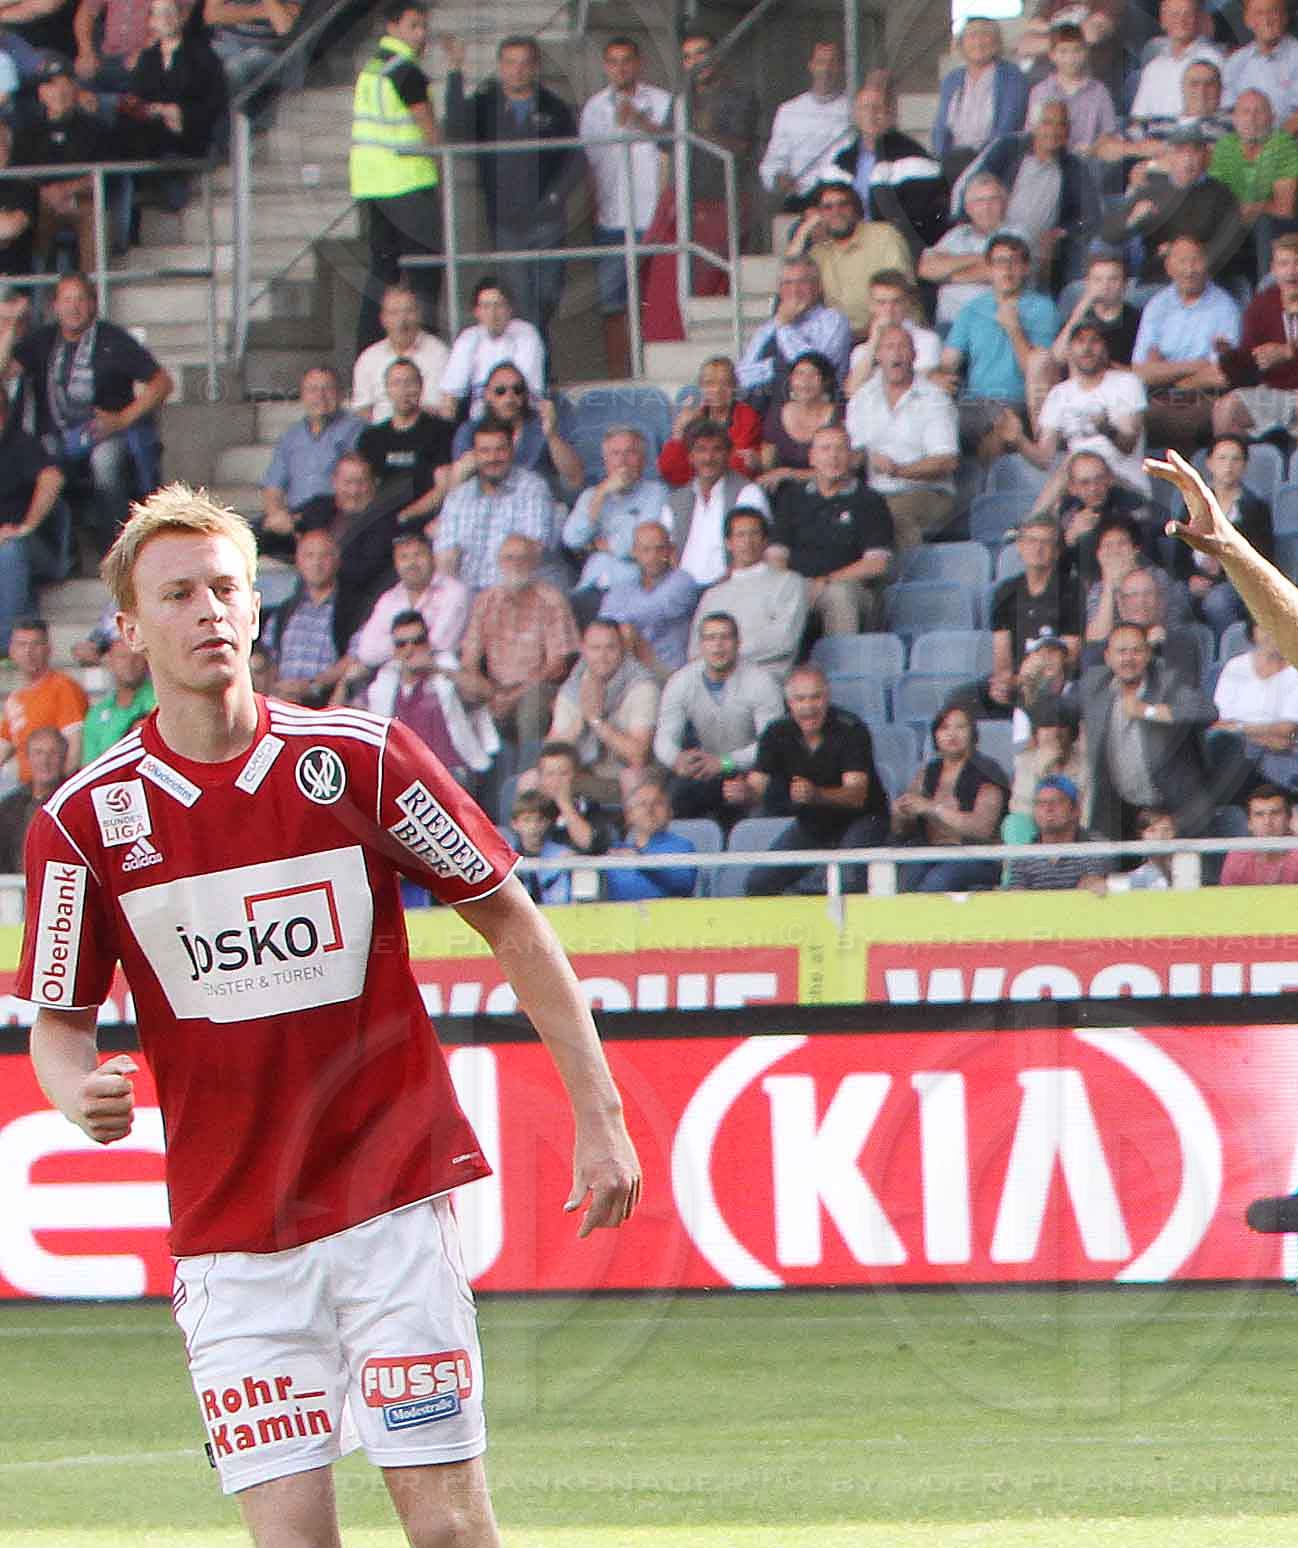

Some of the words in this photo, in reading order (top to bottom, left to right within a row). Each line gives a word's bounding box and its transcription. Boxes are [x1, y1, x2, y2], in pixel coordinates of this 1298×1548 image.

[105, 822, 146, 842] LIGA
[394, 821, 450, 875] BIER
[403, 786, 485, 881] RIEDER
[121, 852, 163, 872] adidas
[41, 864, 78, 1003] Oberbank
[176, 916, 319, 981] josko
[258, 976, 270, 988] &
[762, 1066, 1132, 1267] KIA
[365, 1359, 471, 1400] FUSSL
[211, 1406, 332, 1459] Kamin
